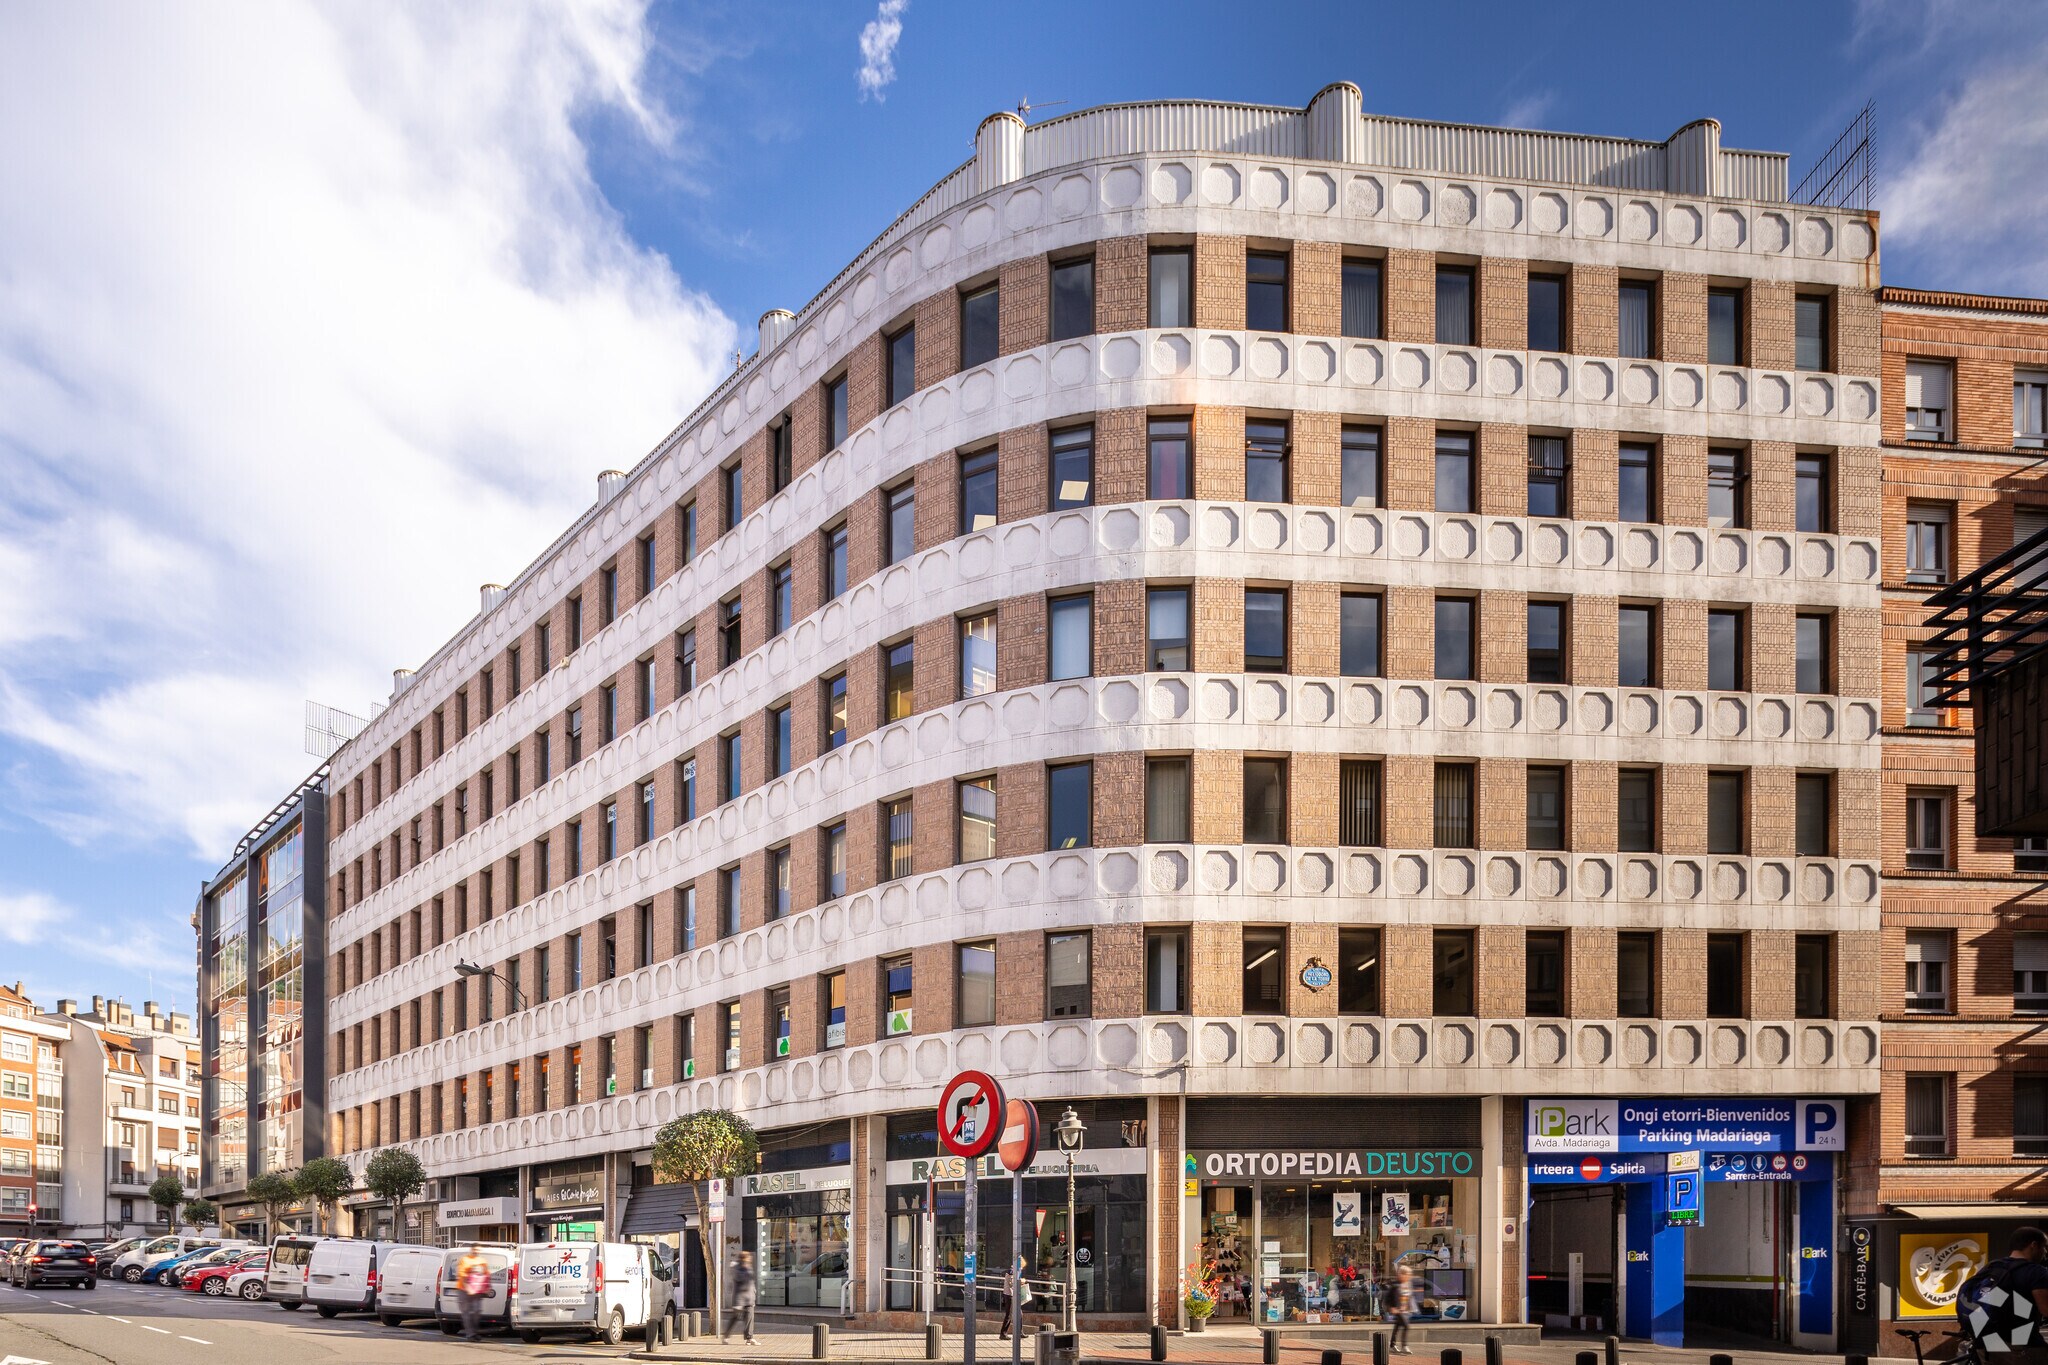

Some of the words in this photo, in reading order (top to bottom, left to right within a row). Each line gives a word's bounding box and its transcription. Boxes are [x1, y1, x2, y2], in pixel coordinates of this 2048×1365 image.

[1535, 1107, 1610, 1136] iPark
[1624, 1108, 1658, 1124] Ongi
[1662, 1108, 1790, 1122] etorri-Bienvenidos
[1638, 1128, 1692, 1145] Parking
[1696, 1128, 1771, 1145] Madariaga
[1819, 1137, 1829, 1145] 24
[1831, 1137, 1836, 1145] h
[1535, 1139, 1560, 1147] Avda.
[1563, 1139, 1610, 1148] Madariaga
[1205, 1152, 1362, 1176] ORTOPEDIA
[1366, 1152, 1473, 1175] DEUSTO
[1795, 1158, 1804, 1166] 20
[1534, 1163, 1574, 1175] Irteera
[1610, 1162, 1646, 1175] Salida
[1725, 1171, 1792, 1180] Sarrera-Entrada
[747, 1173, 806, 1194] RASEL
[541, 1194, 560, 1203] VIAJES
[1671, 1210, 1695, 1219] LIBRE
[1627, 1250, 1648, 1262] iPark
[1801, 1247, 1827, 1259] iPark
[530, 1262, 582, 1278] sending
[1853, 1247, 1867, 1311] CAFÉ-BAR
